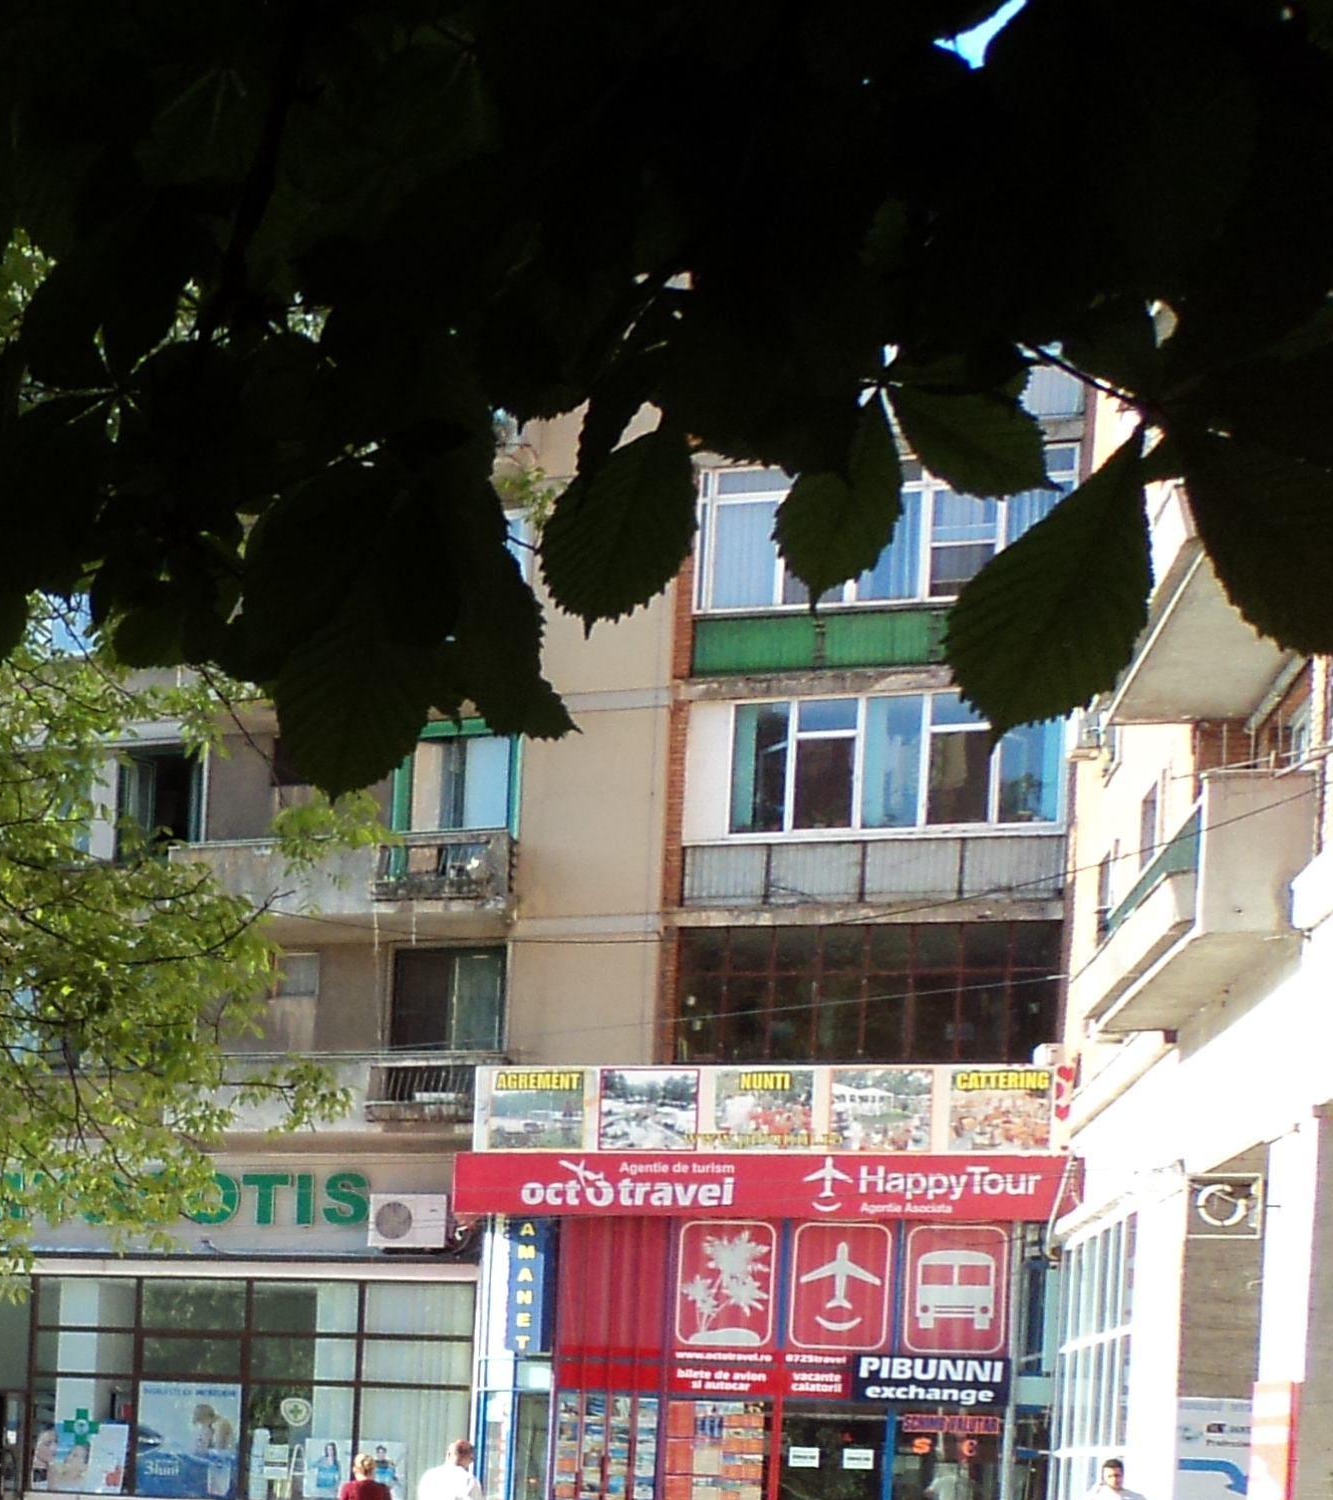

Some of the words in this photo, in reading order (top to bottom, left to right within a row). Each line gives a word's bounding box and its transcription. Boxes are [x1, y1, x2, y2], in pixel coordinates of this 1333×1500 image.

[496, 1073, 580, 1090] AGREMENT
[740, 1073, 790, 1090] NUNTI
[956, 1072, 1049, 1090] CATTERING
[619, 1161, 669, 1175] Agentie
[672, 1162, 689, 1173] de
[692, 1163, 735, 1174] turism
[859, 1165, 1042, 1200] HappyTour
[860, 1202, 902, 1214] Agentie
[515, 1222, 536, 1350] AMANET
[675, 1351, 773, 1362] www.octotravel.ro
[676, 1368, 712, 1379] bilete
[714, 1370, 730, 1380] de
[733, 1371, 767, 1382] avion
[792, 1372, 842, 1382] vacante
[859, 1357, 1003, 1383] PIBUNNI
[704, 1380, 751, 1391] autocar
[791, 1382, 842, 1393] calatorii
[865, 1385, 995, 1405] exchange
